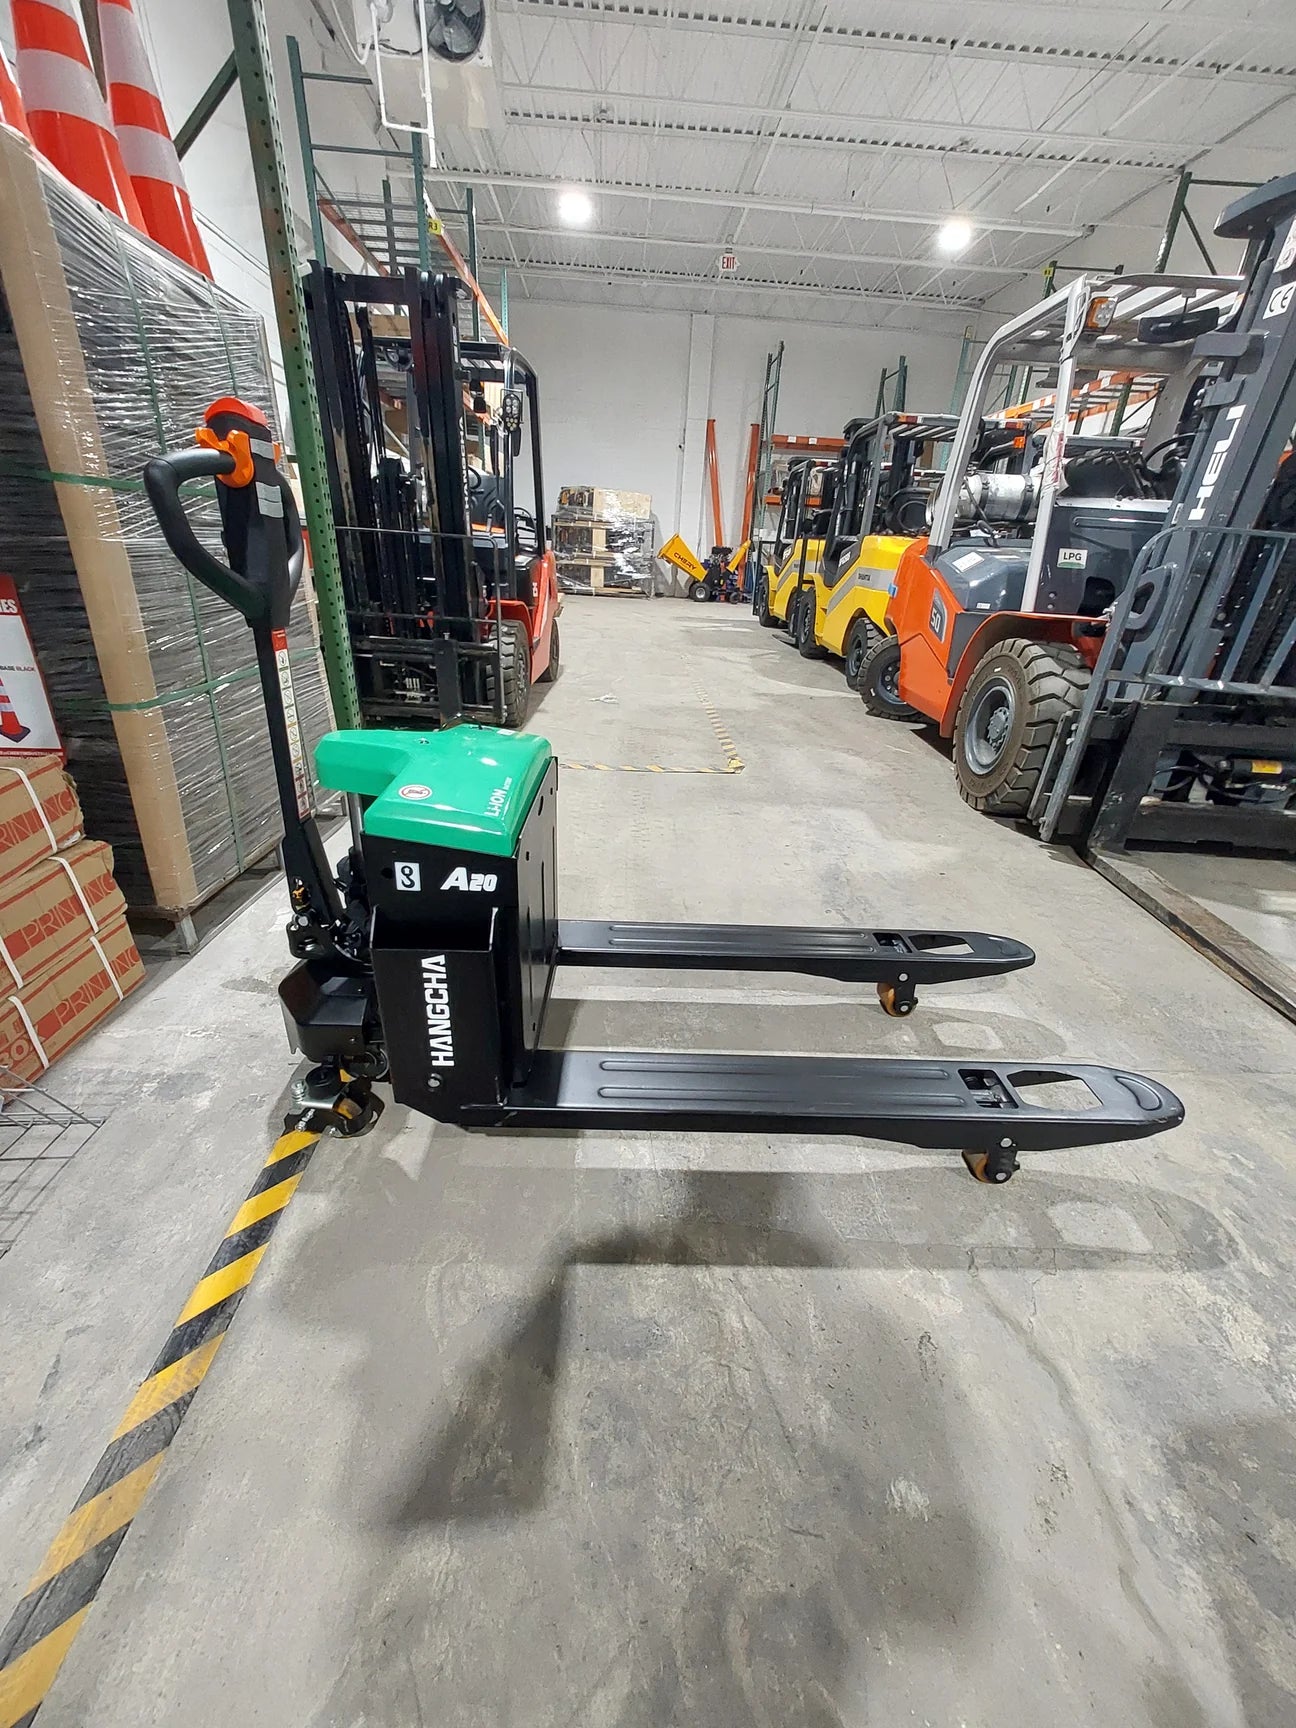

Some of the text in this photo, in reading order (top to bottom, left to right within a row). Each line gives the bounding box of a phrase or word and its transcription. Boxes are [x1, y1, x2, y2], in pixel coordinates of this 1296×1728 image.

[721, 256, 735, 270] EXIT
[1187, 404, 1247, 520] HELI
[1063, 552, 1082, 562] LPG
[930, 606, 942, 633] 50
[440, 866, 498, 892] A20
[421, 954, 455, 1067] HANGCHA
